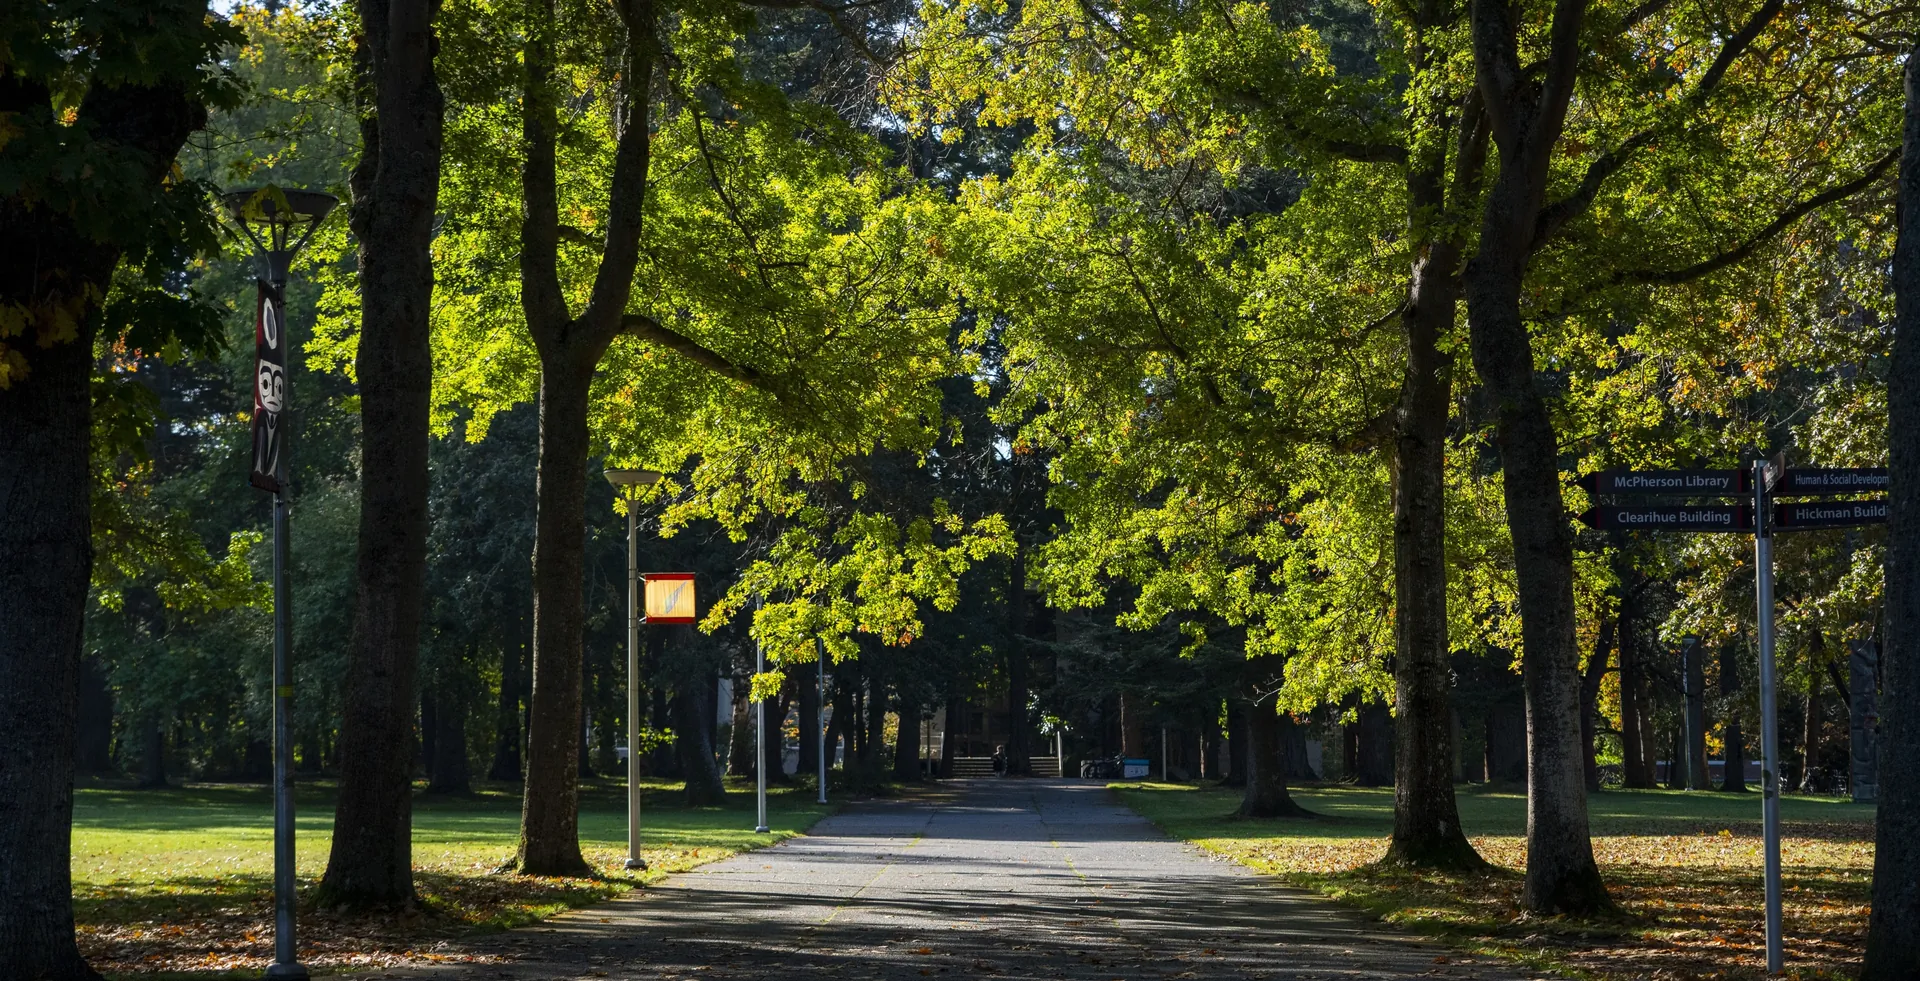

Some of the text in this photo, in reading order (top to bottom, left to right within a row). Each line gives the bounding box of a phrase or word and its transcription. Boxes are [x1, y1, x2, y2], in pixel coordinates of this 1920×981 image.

[1614, 475, 1730, 488] McPherson Library
[1795, 475, 1822, 485] Human
[1823, 475, 1829, 485] &
[1830, 474, 1851, 485] Social
[1617, 511, 1731, 525] Clearihue Building
[1796, 507, 1850, 520] Hickman
